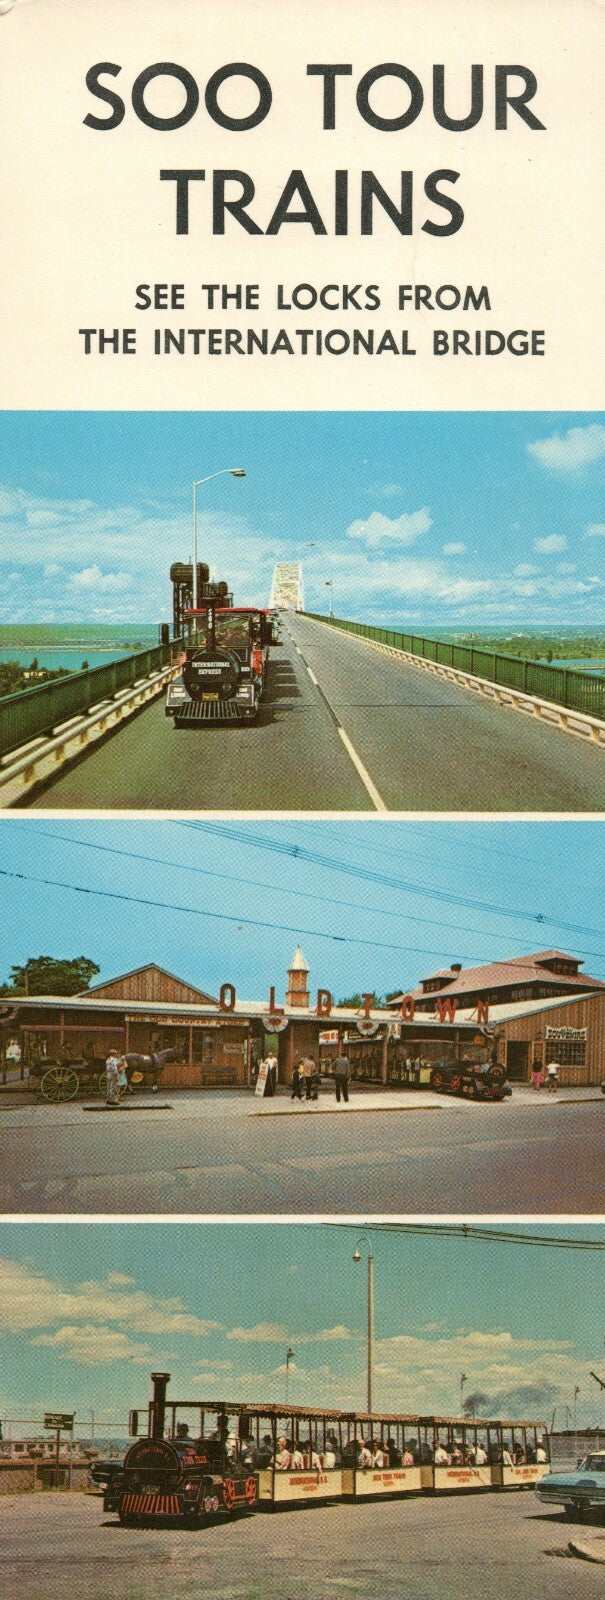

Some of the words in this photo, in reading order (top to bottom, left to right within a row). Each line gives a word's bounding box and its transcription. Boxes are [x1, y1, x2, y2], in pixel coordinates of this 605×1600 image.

[83, 62, 273, 131] SOO
[306, 63, 546, 131] TOUR
[160, 169, 464, 236] TRAINS
[135, 284, 185, 310] SEE
[202, 284, 259, 310] THE
[278, 284, 380, 310] LOCKS
[399, 285, 491, 310] FROM
[79, 329, 136, 355] THE
[154, 329, 416, 356] INTERNATIONAL
[434, 330, 545, 356] BRIDGE
